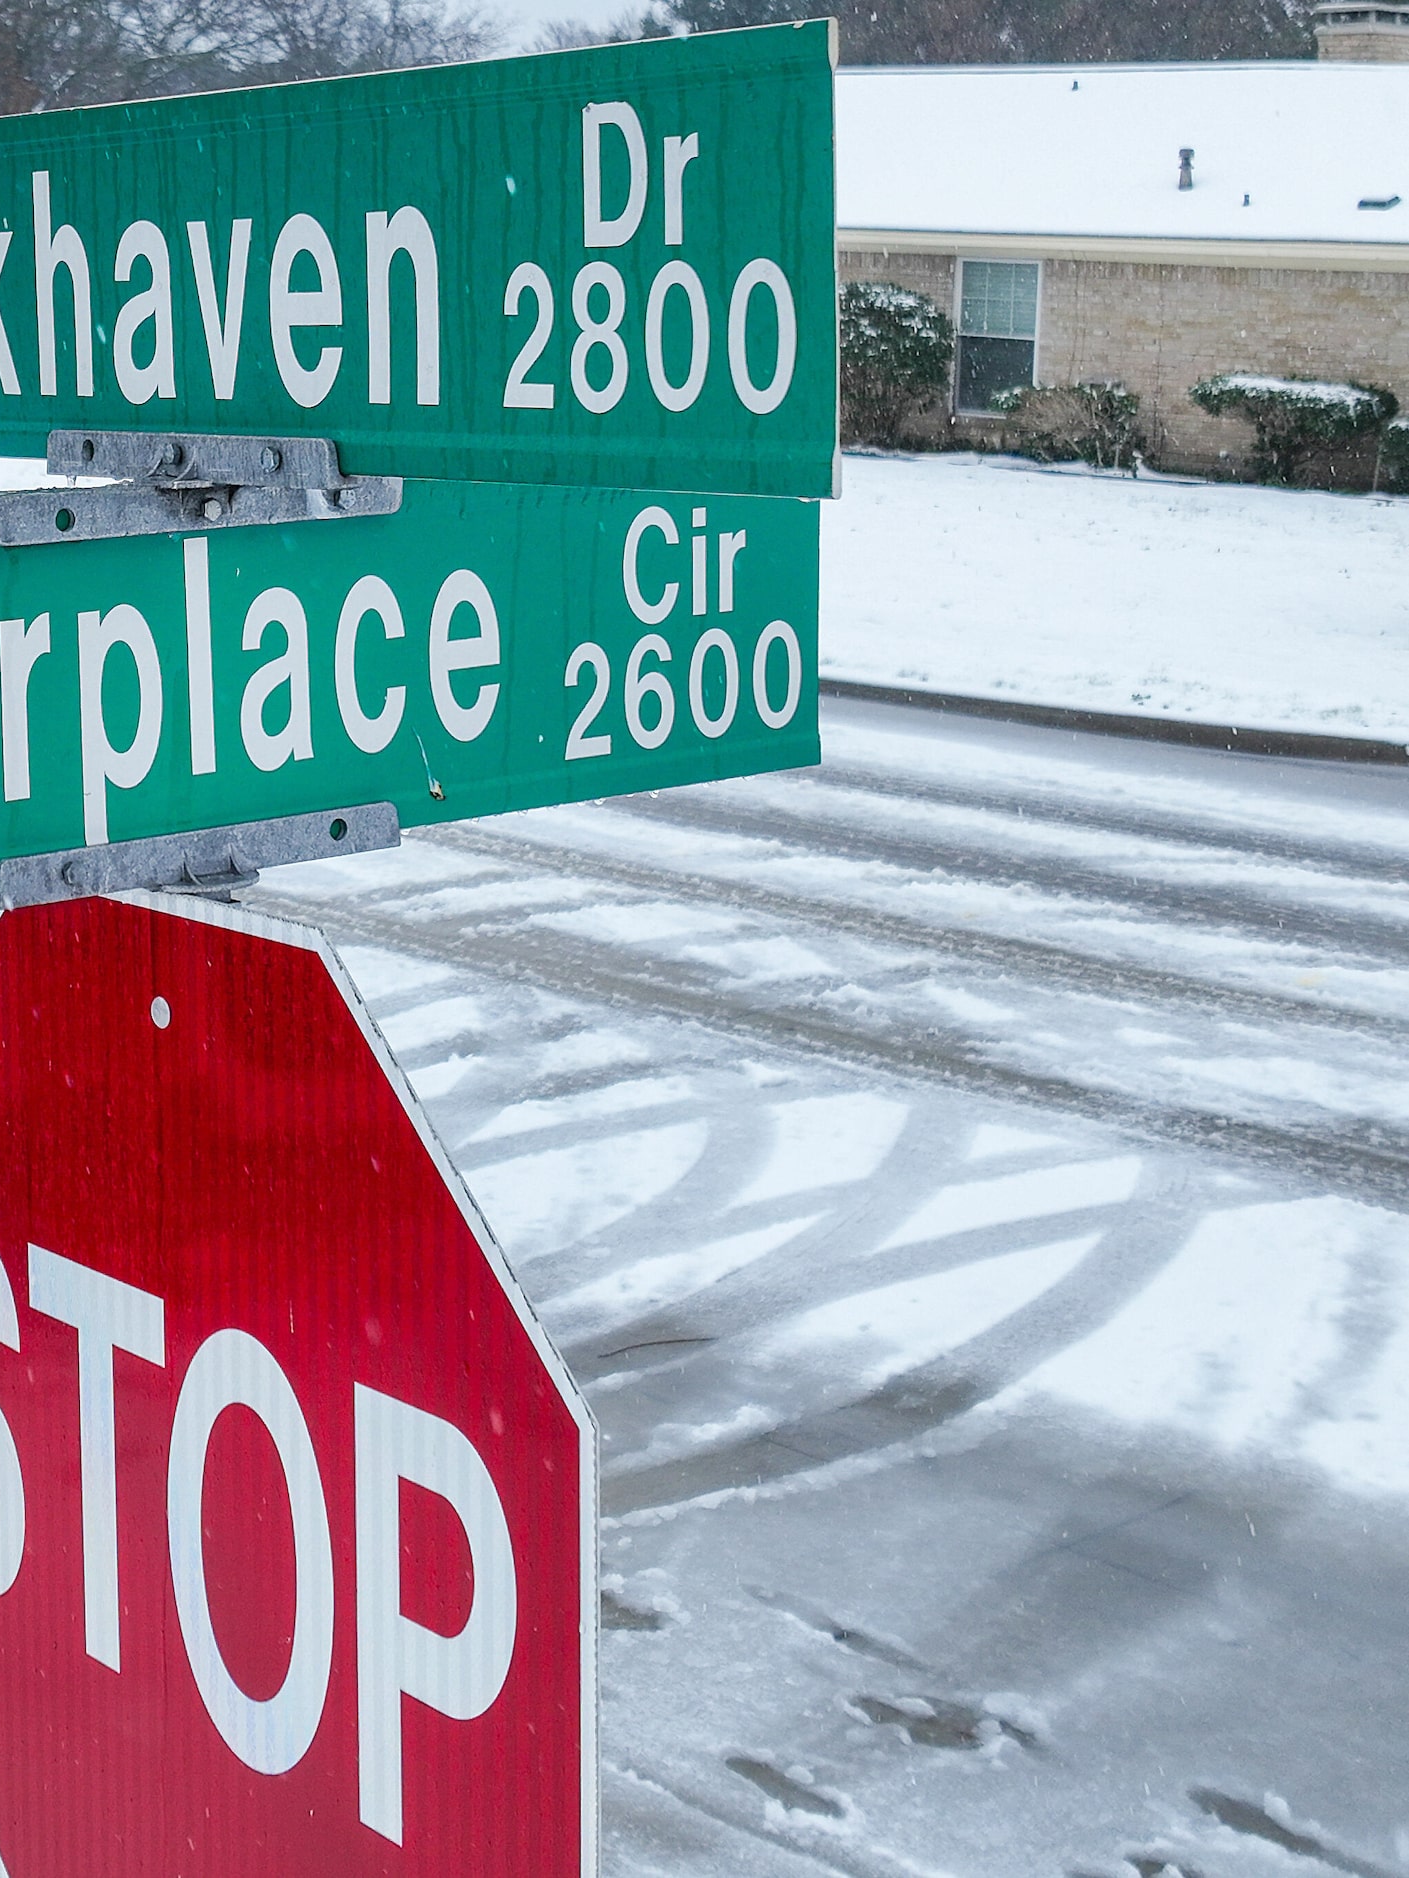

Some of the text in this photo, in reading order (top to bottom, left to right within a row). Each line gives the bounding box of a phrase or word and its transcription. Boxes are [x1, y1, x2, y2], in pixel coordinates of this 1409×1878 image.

[582, 101, 699, 248] Dr
[503, 258, 797, 415] 2800
[622, 506, 747, 625] Cir
[564, 619, 802, 761] 2600
